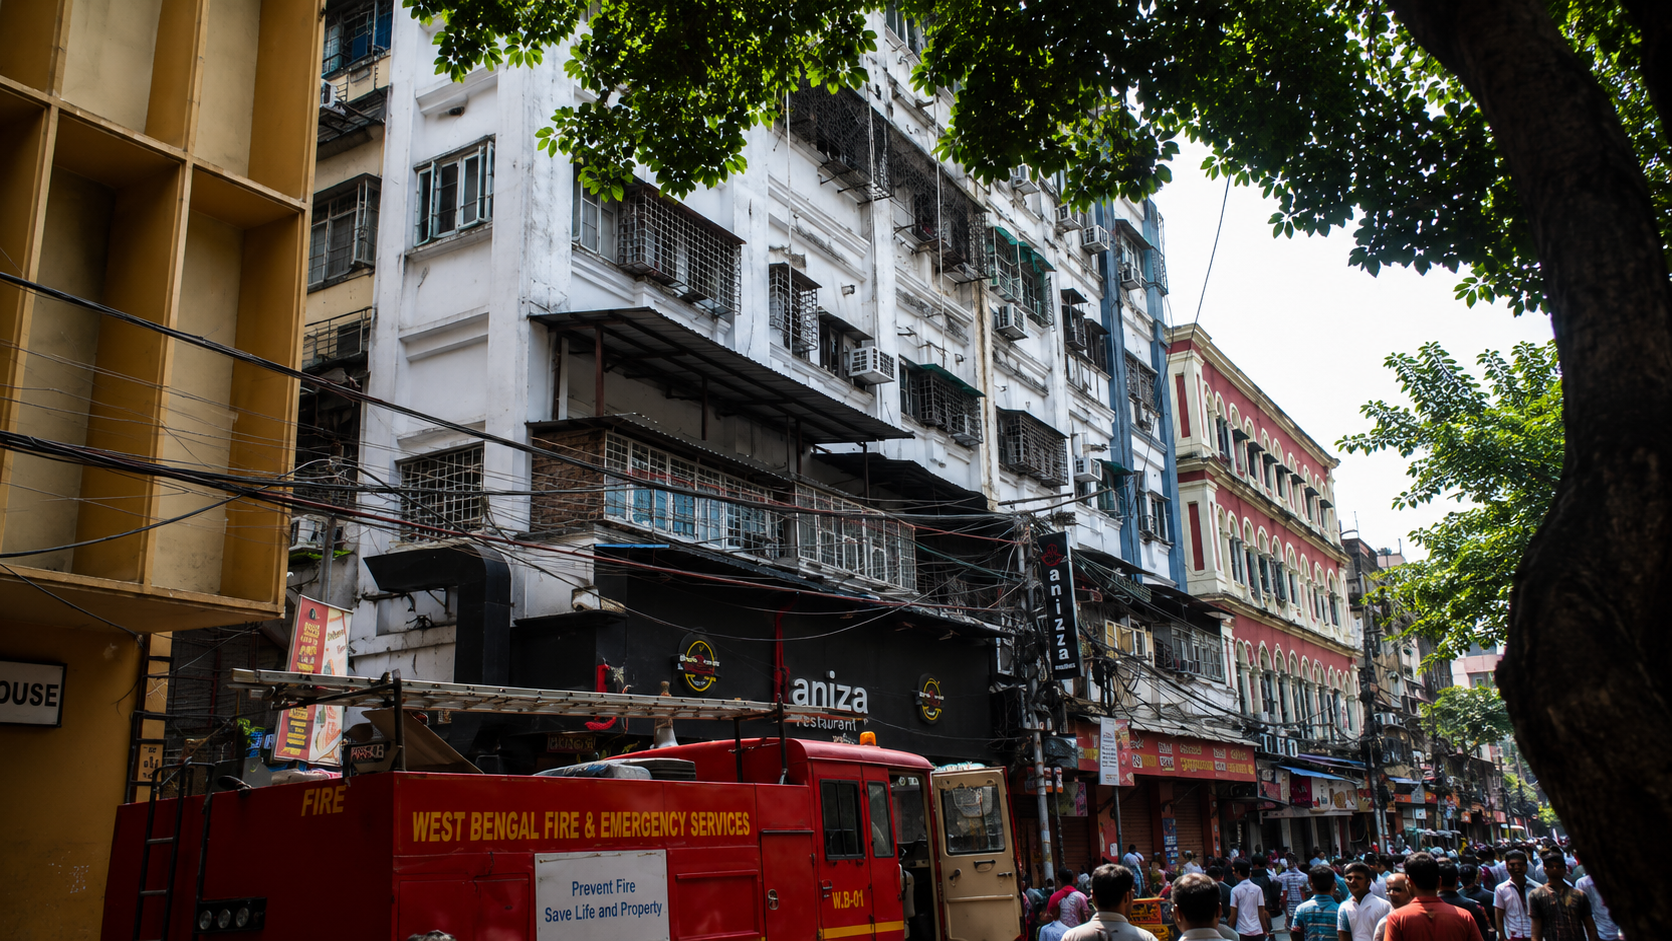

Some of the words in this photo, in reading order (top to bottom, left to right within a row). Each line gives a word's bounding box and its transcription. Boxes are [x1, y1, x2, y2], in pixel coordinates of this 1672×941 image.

[1049, 568, 1070, 661] anizza
[792, 669, 869, 714] aniza
[301, 785, 347, 817] FIRE
[413, 811, 466, 842] WEST
[470, 811, 540, 841] BENGAL
[545, 811, 580, 839] FIRE
[584, 811, 596, 839] &
[601, 811, 686, 838] EMERGENCY
[690, 811, 750, 836] SERVICES
[572, 880, 613, 897] Prevent
[616, 878, 636, 894] Fire
[545, 906, 572, 922] Save
[575, 903, 595, 920] Life
[598, 902, 618, 919] and
[621, 900, 662, 918] Property
